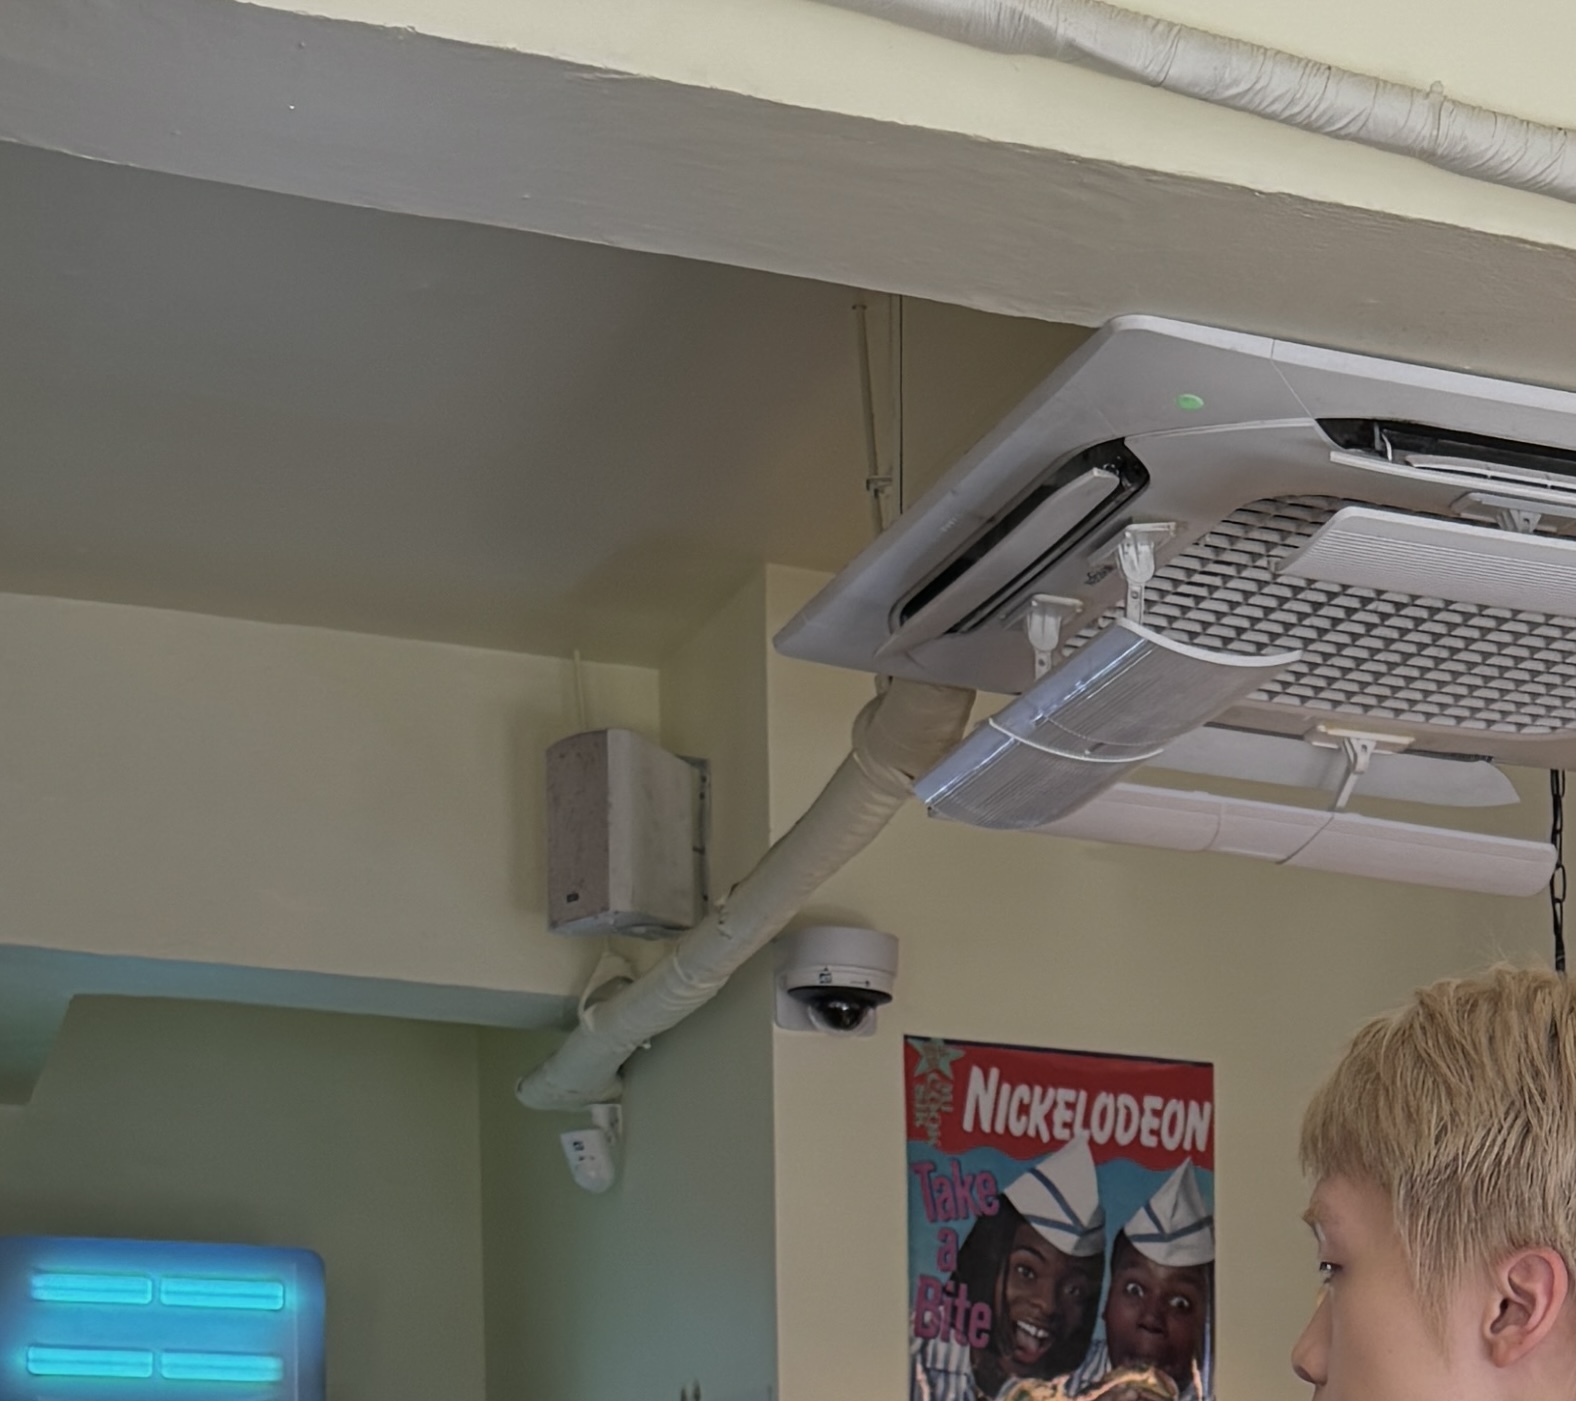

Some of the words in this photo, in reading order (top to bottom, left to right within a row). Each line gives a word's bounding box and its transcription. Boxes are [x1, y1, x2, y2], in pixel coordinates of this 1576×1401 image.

[963, 1064, 1213, 1152] NICKELODEON
[911, 1160, 999, 1223] Take
[936, 1227, 957, 1271] a
[913, 1275, 993, 1349] Bite
